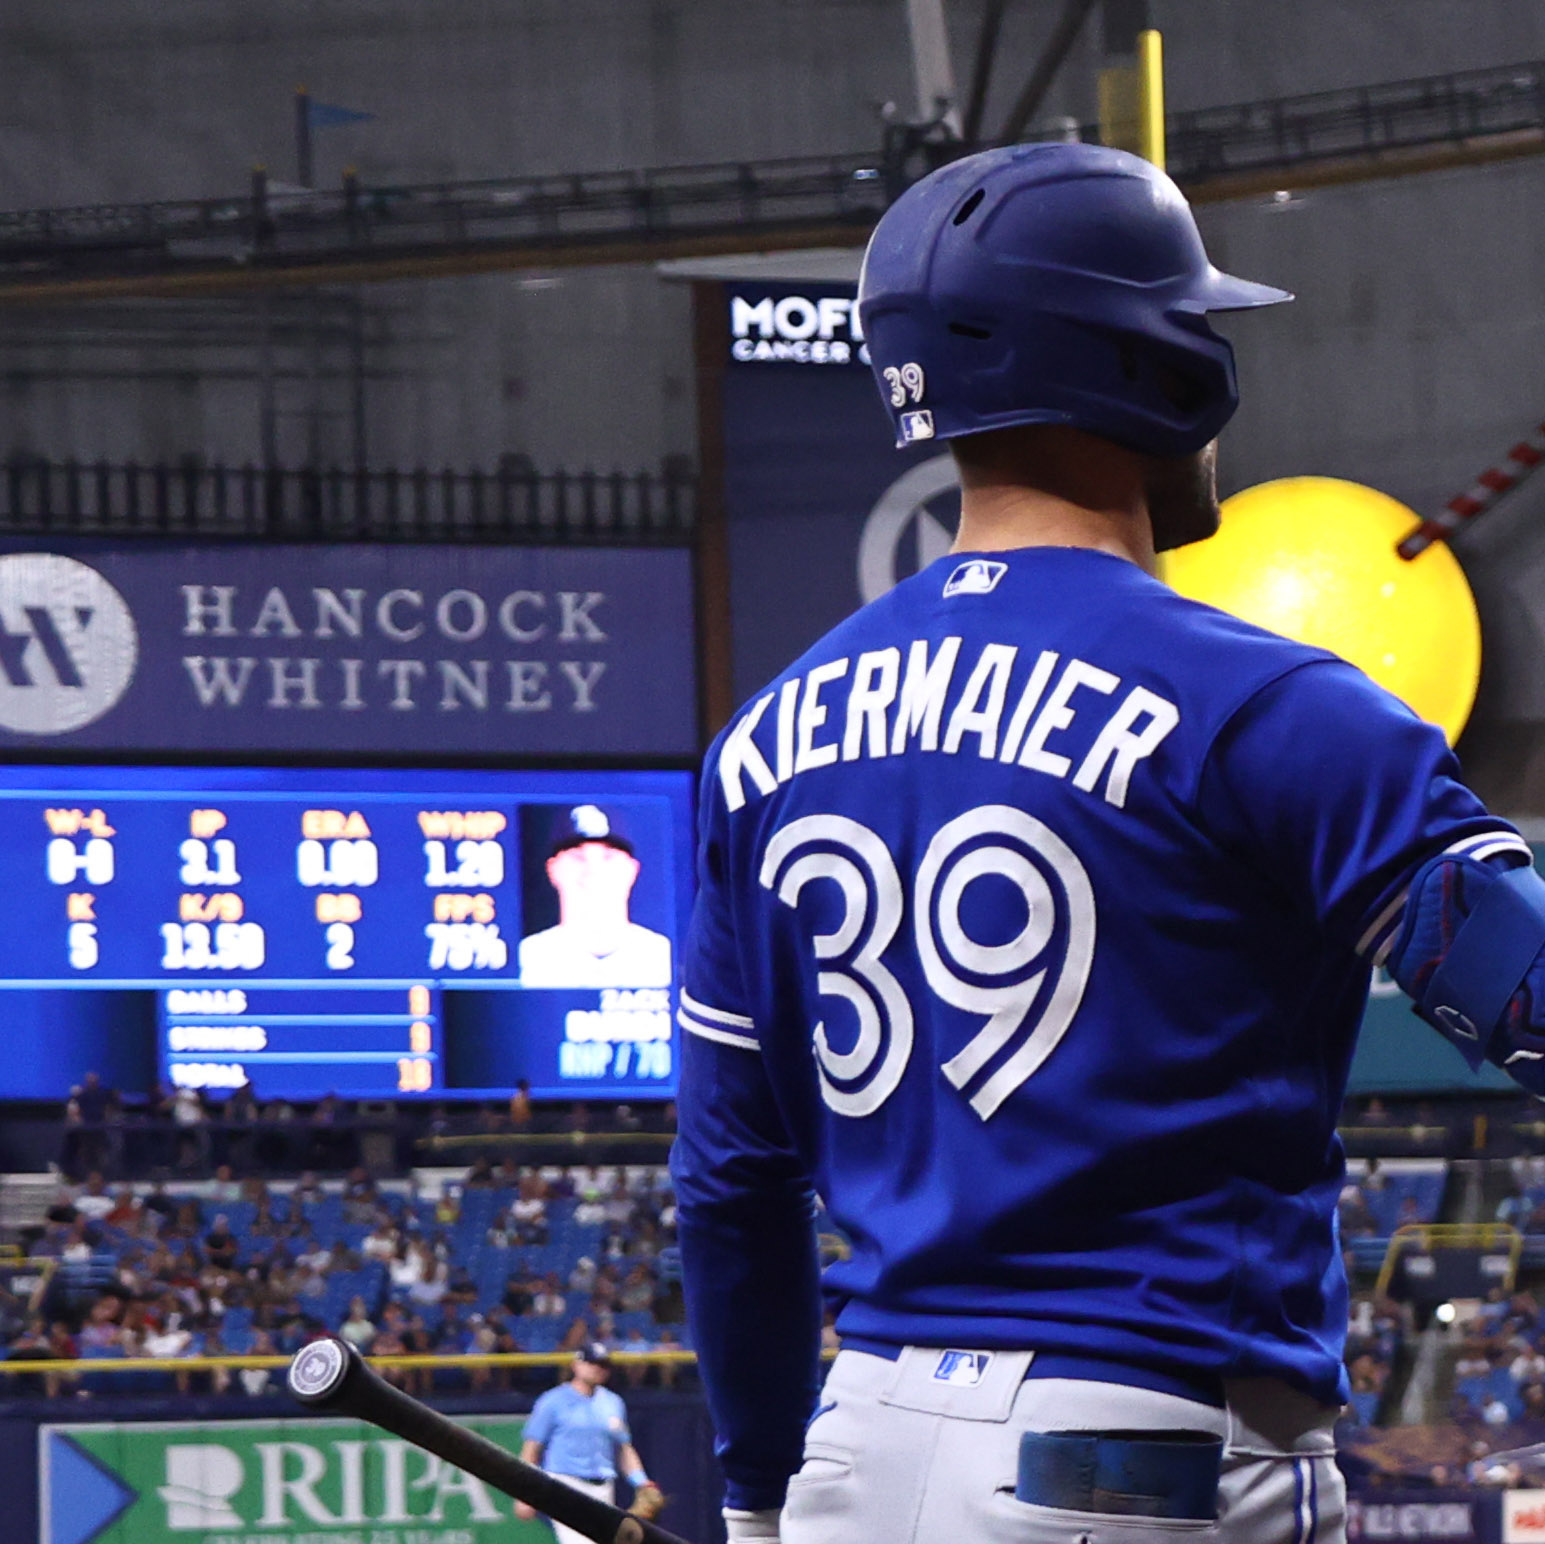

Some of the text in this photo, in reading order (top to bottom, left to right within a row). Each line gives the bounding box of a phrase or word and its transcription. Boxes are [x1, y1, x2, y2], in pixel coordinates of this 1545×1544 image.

[732, 338, 851, 365] CANCER
[883, 362, 925, 407] 39
[182, 585, 607, 642] HANCOCK
[182, 655, 607, 713] WHITNEY
[718, 636, 1181, 813] KIERMAIER
[302, 809, 372, 840] ERA
[66, 892, 98, 922] K
[326, 922, 355, 970] 2
[759, 804, 1096, 1121] 39
[253, 1438, 505, 1529] RIPA
